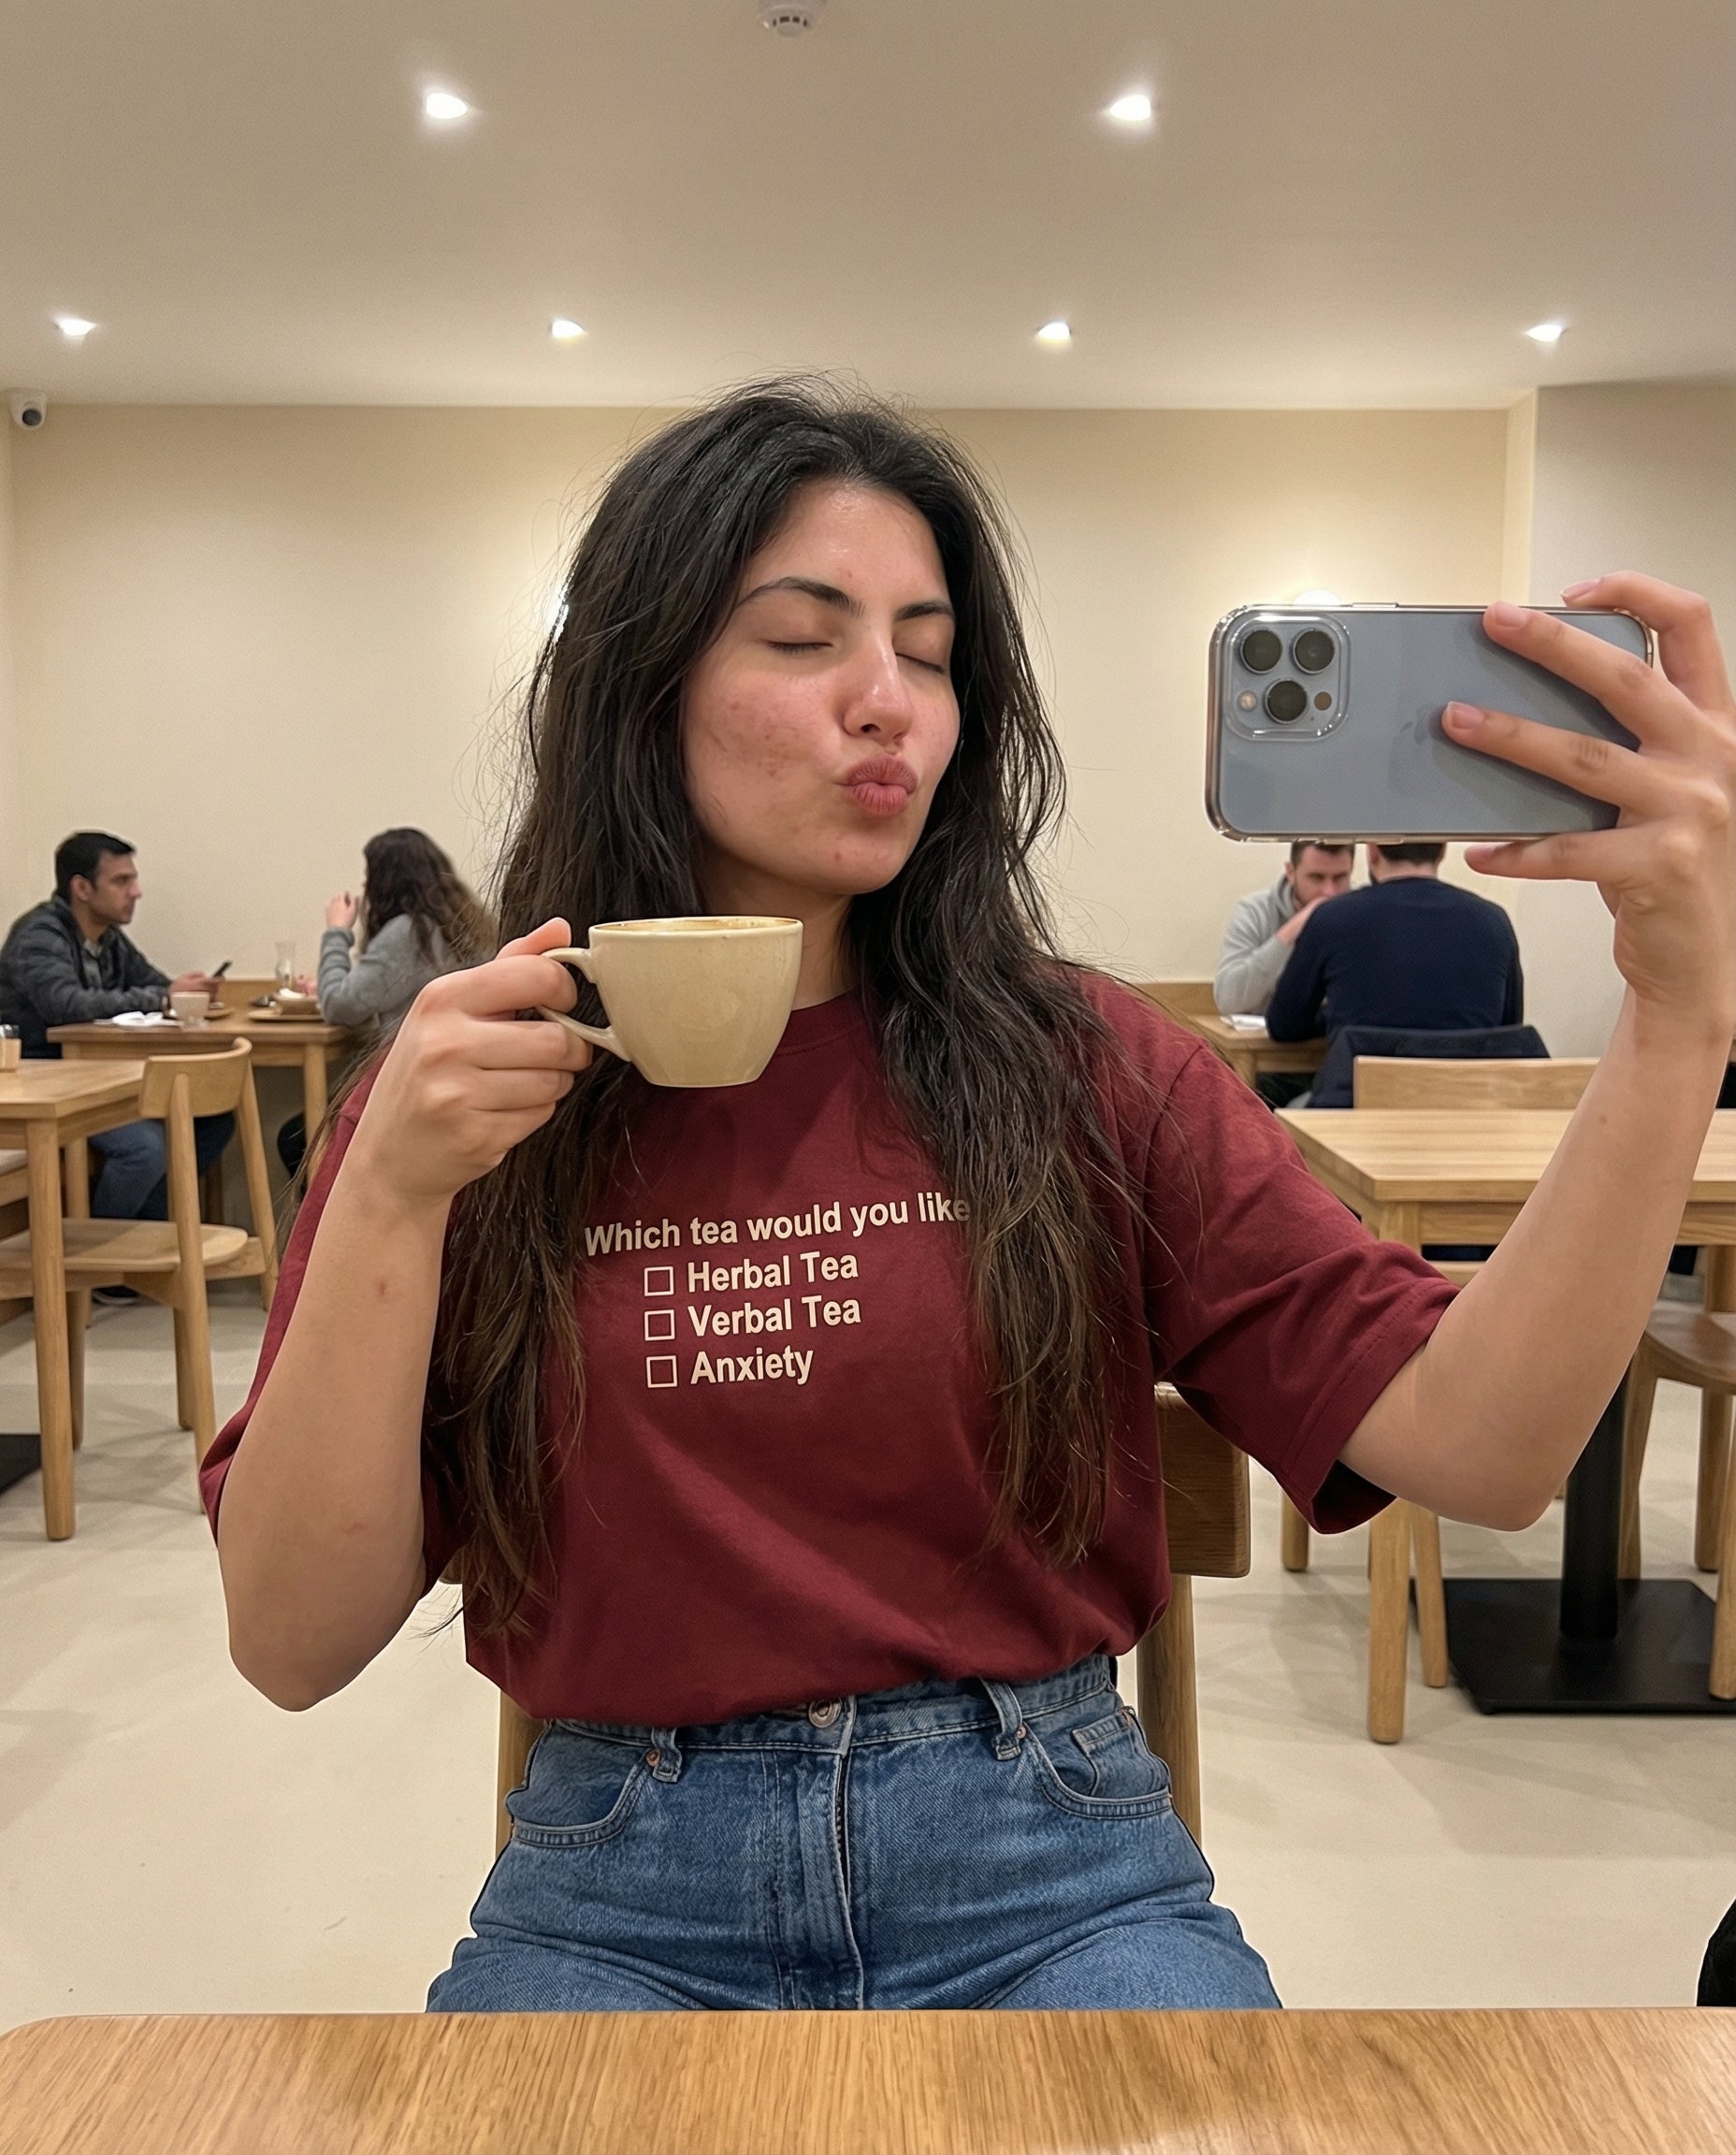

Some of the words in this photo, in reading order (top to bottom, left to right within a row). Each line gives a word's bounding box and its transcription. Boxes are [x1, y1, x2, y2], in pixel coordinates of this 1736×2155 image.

[585, 1218, 680, 1256] Which
[689, 1217, 737, 1245] tea
[746, 1201, 841, 1241] would
[849, 1200, 909, 1237] you
[687, 1255, 790, 1293] Herbal
[800, 1251, 859, 1283] Tea
[687, 1298, 792, 1337] Verbal
[802, 1294, 861, 1328] Tea
[690, 1345, 814, 1385] Anxiety
